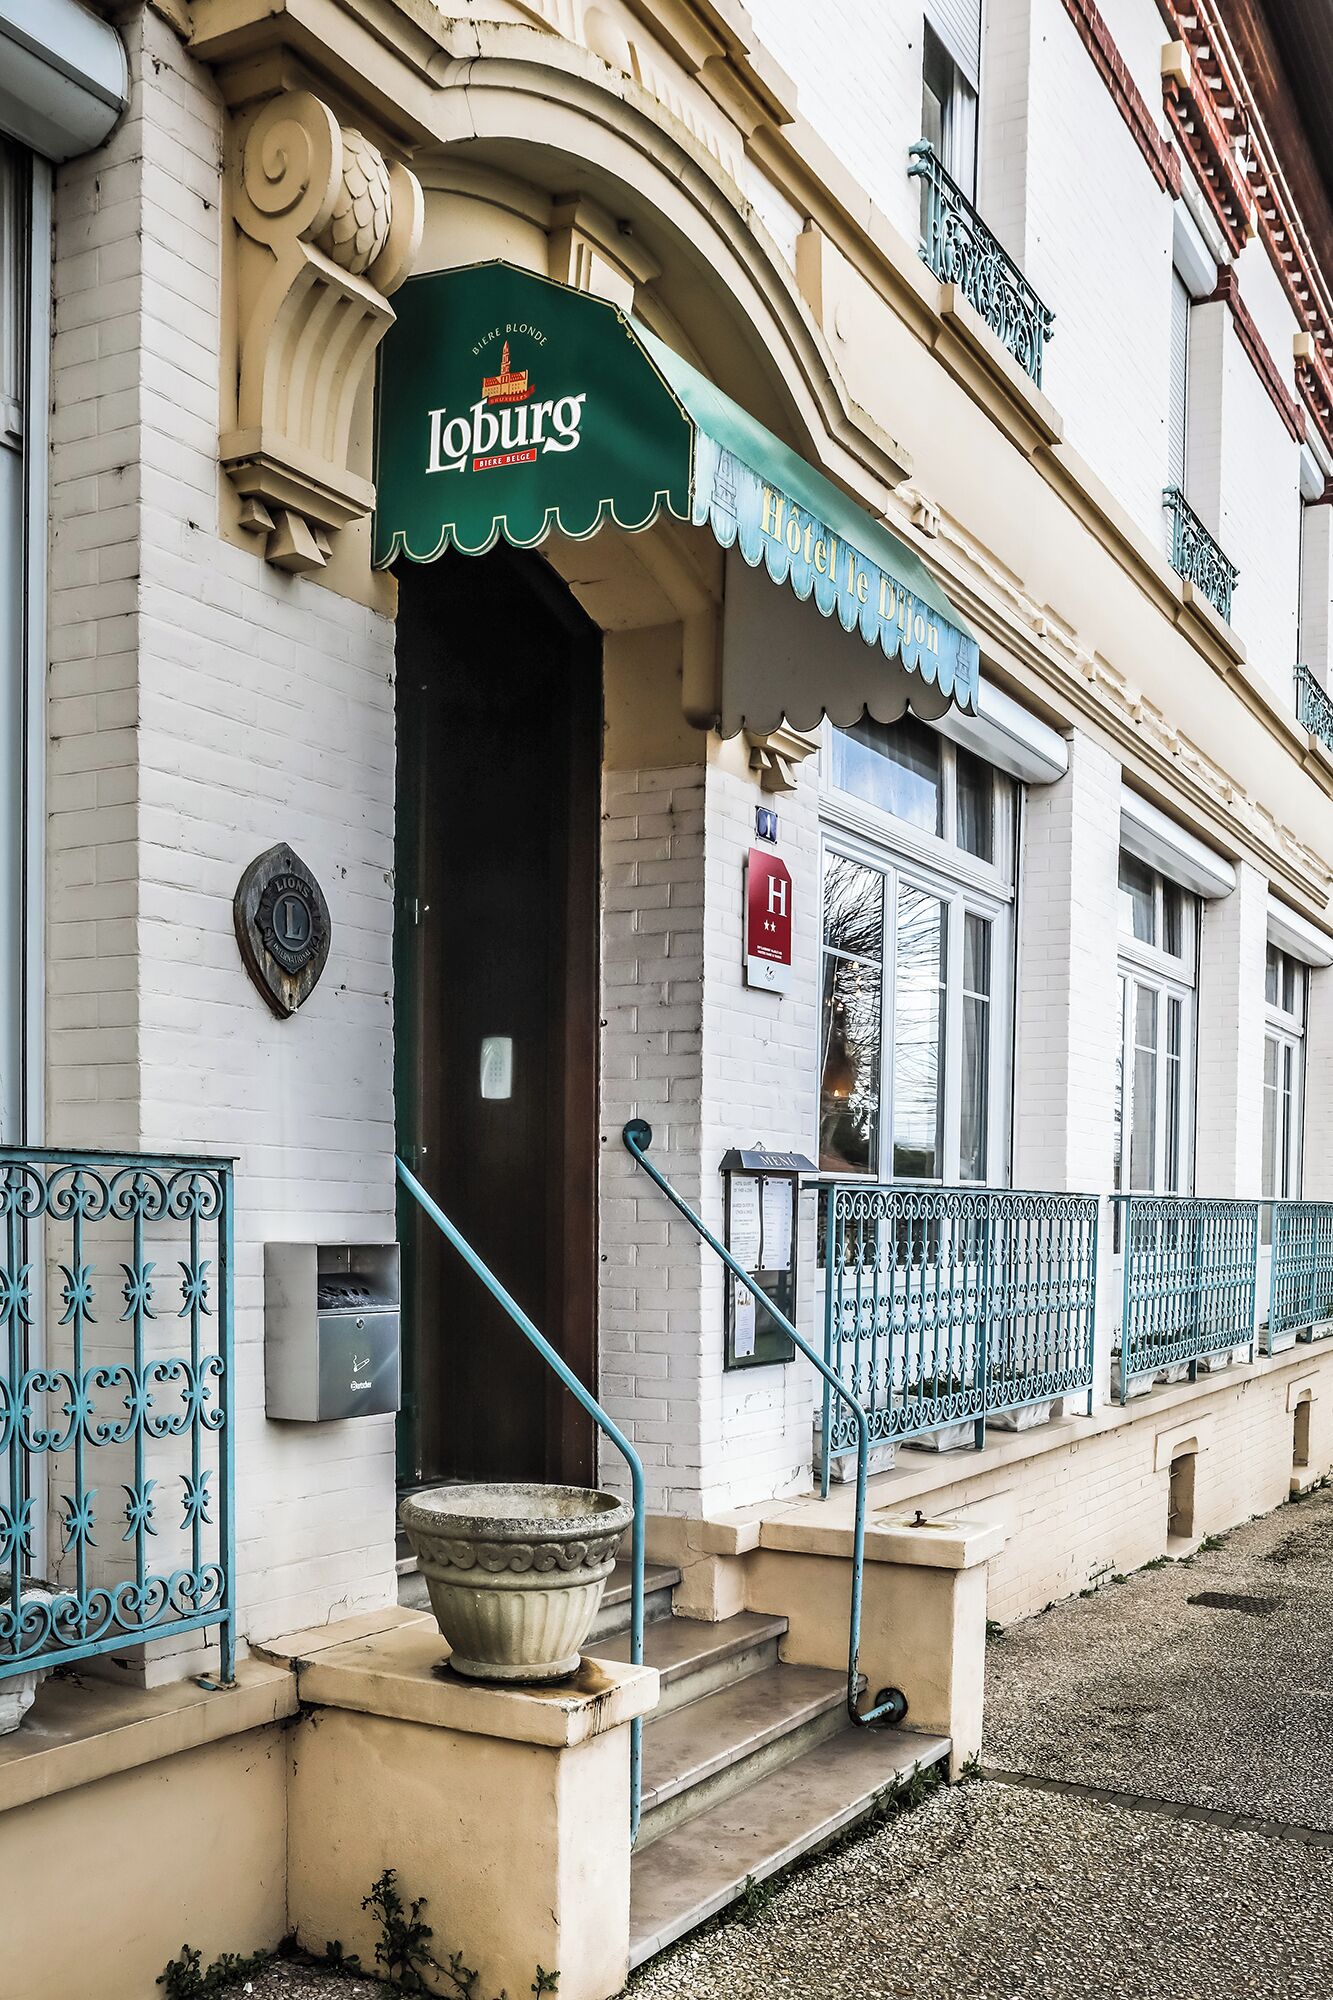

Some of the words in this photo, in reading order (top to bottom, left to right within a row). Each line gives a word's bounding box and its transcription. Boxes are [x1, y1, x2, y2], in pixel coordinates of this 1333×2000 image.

[472, 327, 501, 355] BIERE
[506, 323, 548, 347] BLONDE
[425, 393, 587, 474] Loburg
[479, 457, 502, 468] BIERE
[506, 452, 531, 464] BELGE
[759, 487, 838, 583] Hôtel
[846, 552, 870, 604] le
[877, 575, 940, 656] Dijon
[275, 877, 311, 898] LIONS
[766, 874, 788, 918] H
[284, 900, 303, 941] L
[759, 1154, 798, 1167] MENU
